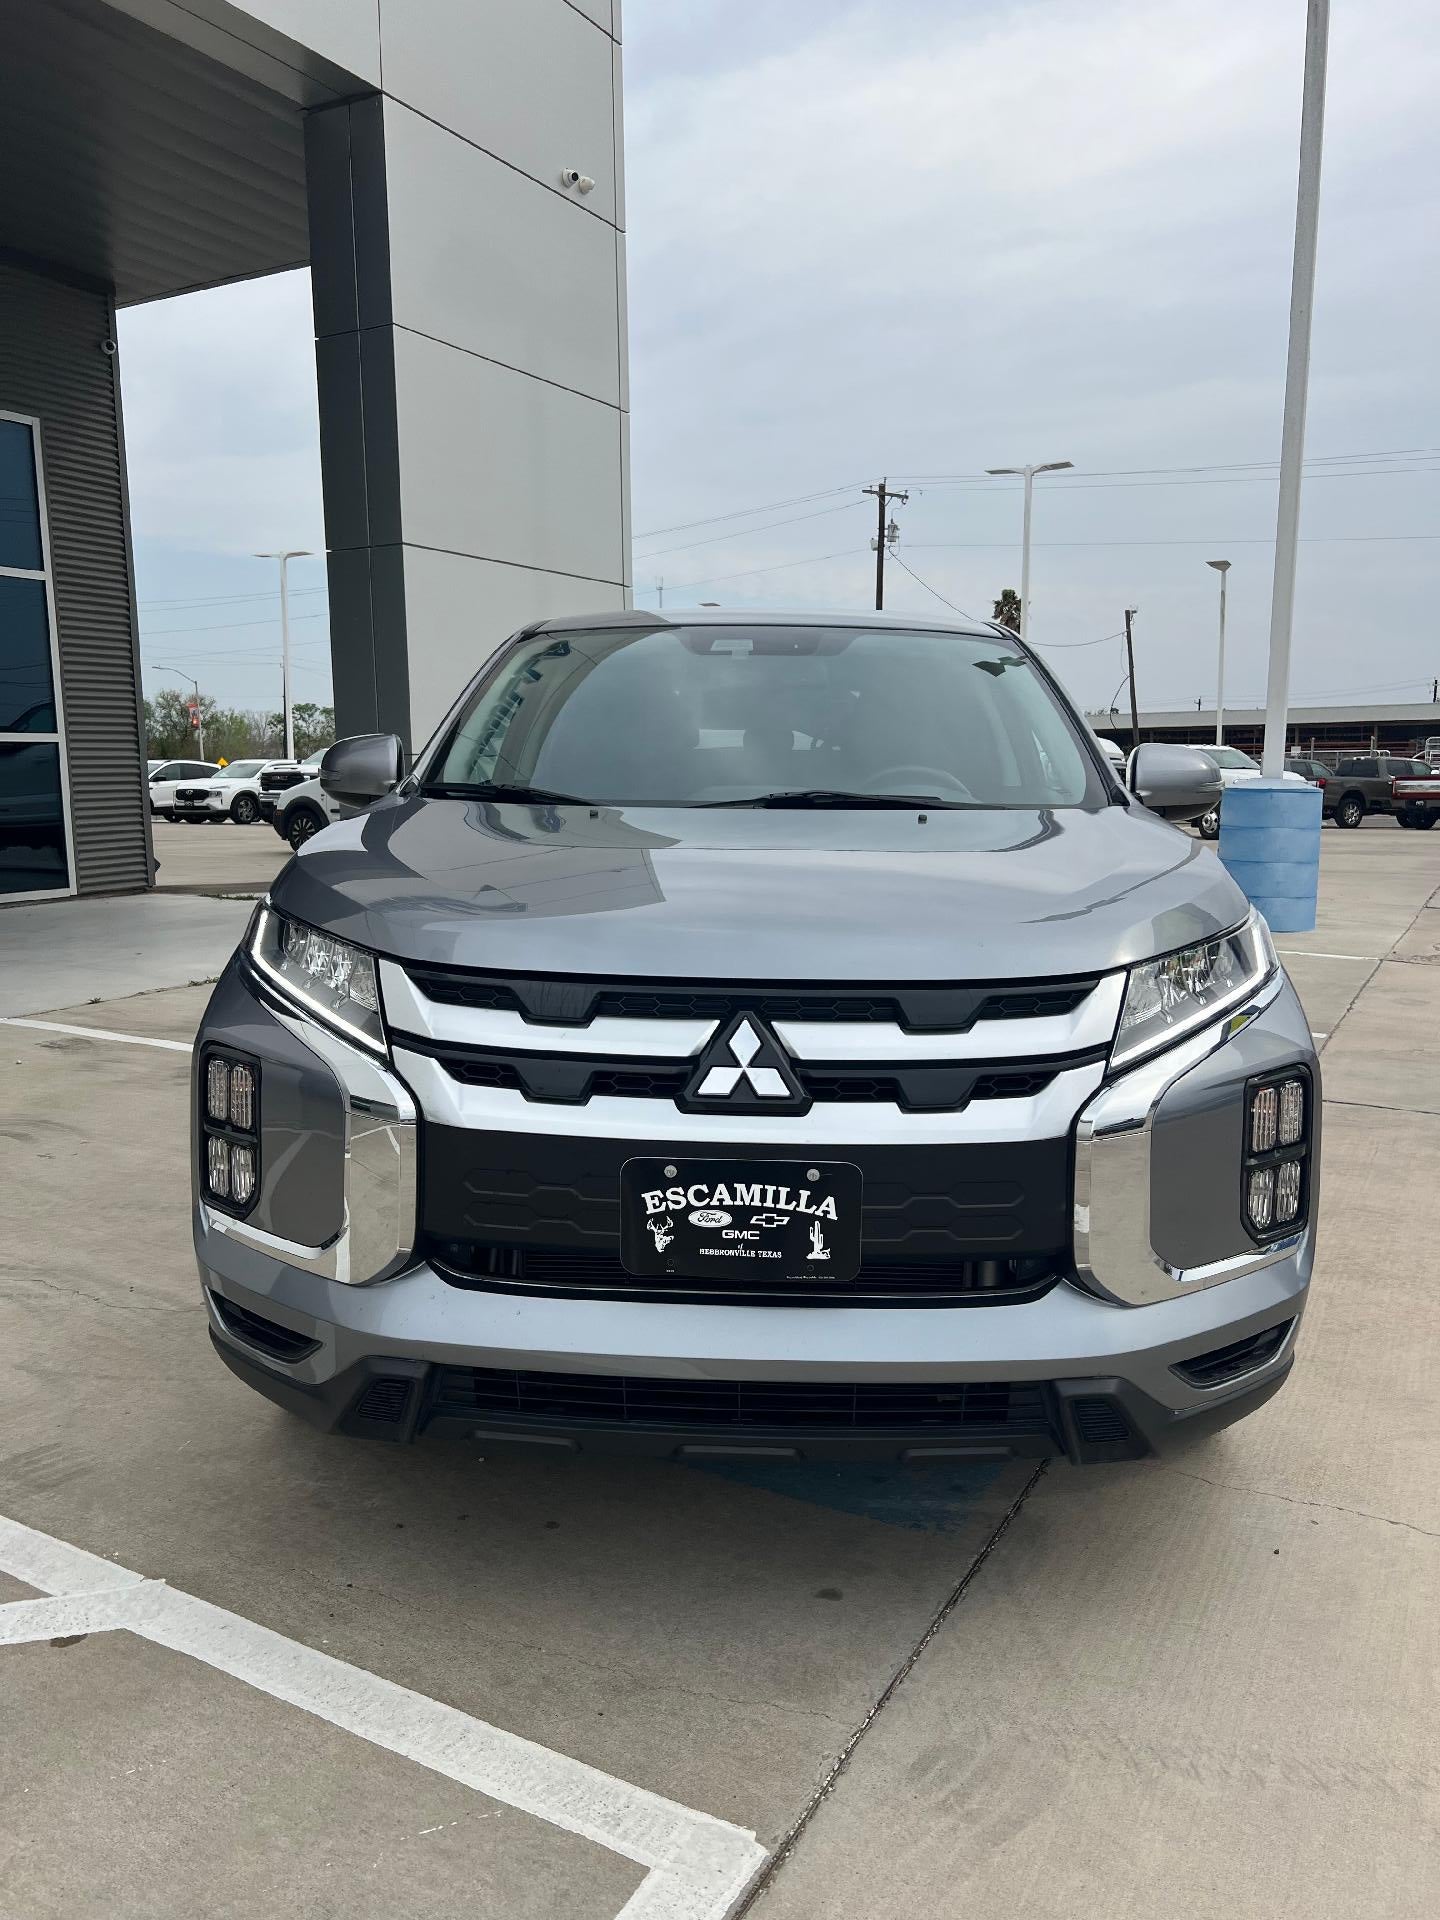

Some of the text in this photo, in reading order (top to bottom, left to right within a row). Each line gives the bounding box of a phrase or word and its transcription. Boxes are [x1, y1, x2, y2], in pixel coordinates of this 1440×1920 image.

[641, 1183, 838, 1220] ESCAMILLA
[697, 1212, 723, 1224] Ford
[721, 1230, 760, 1240] GMC
[757, 1250, 782, 1259] TEXAS
